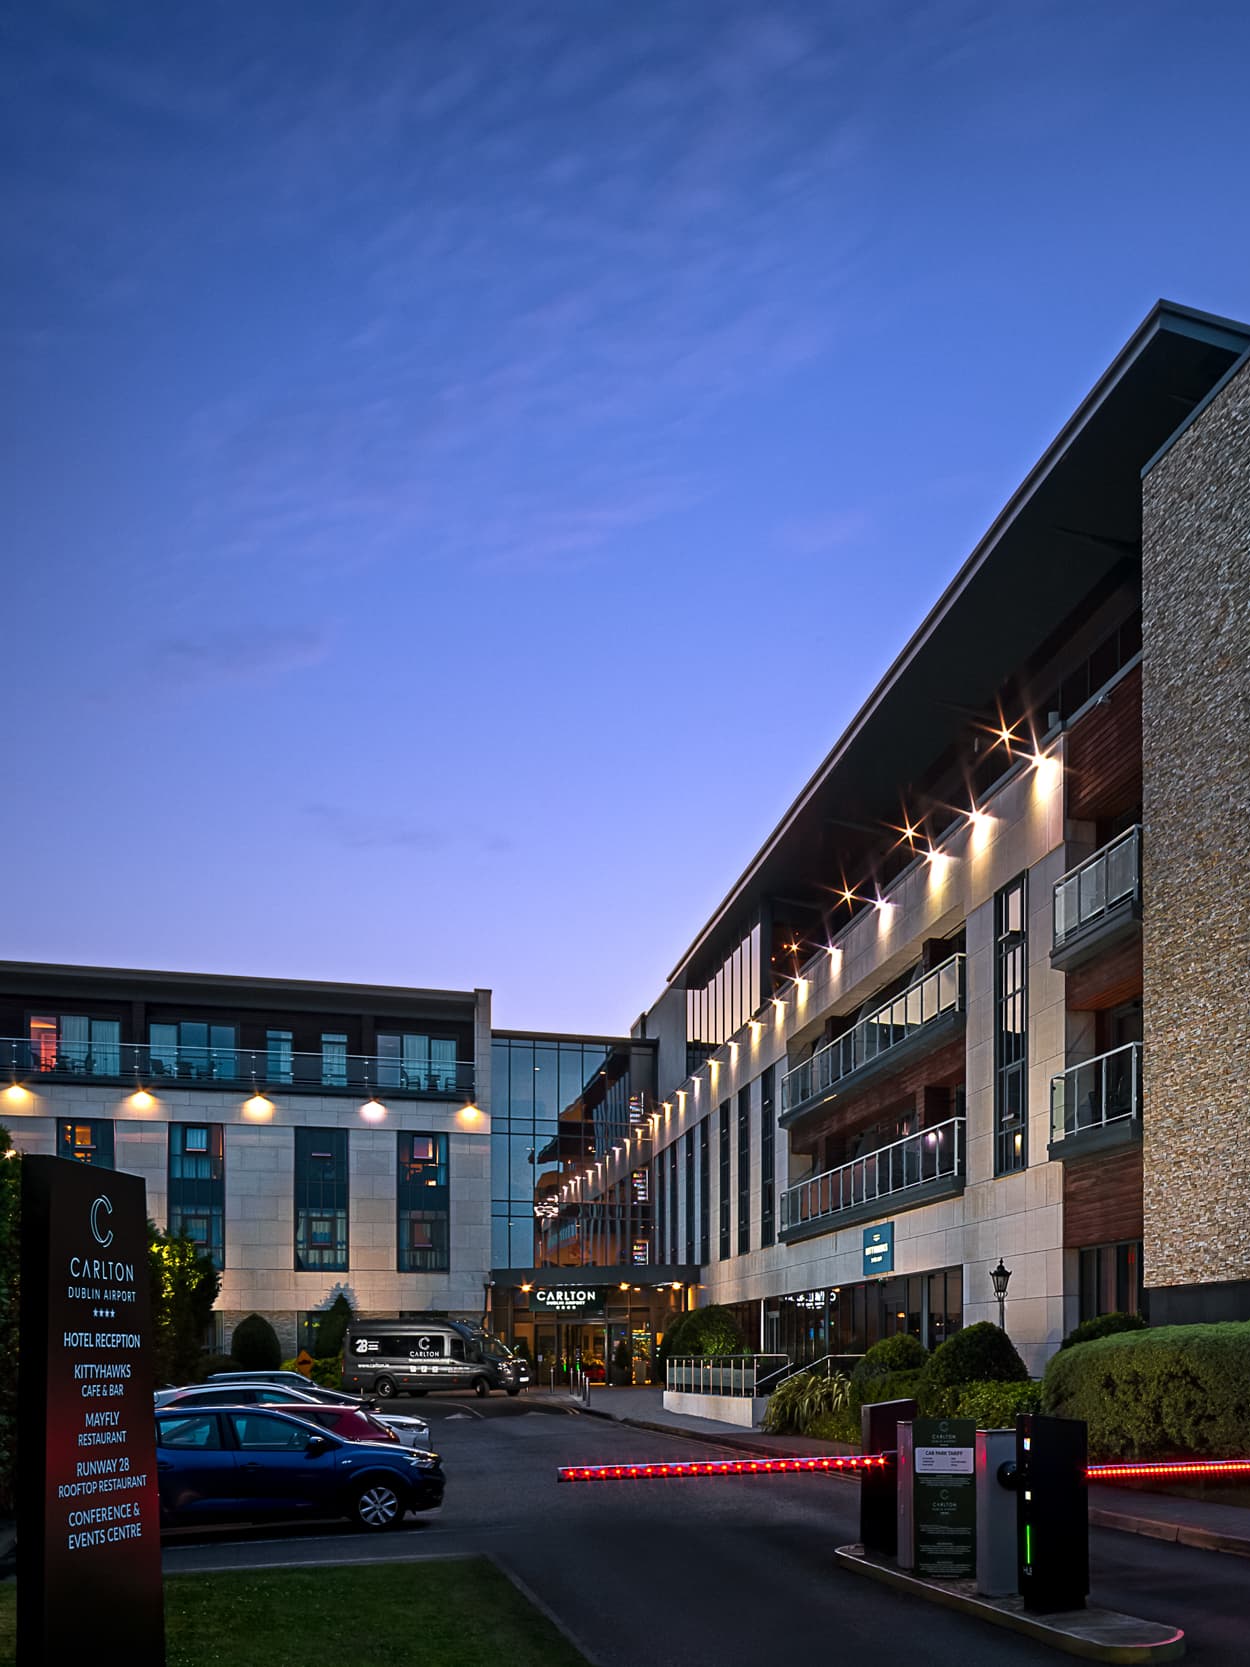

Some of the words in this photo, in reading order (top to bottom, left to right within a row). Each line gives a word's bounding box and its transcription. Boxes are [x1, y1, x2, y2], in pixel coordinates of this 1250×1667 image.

[70, 1257, 135, 1282] CARLTON
[68, 1286, 101, 1300] DUBLIN
[103, 1289, 137, 1302] AIRPORT
[536, 1291, 596, 1301] CARLTON
[63, 1331, 94, 1348] HOTEL
[95, 1332, 141, 1349] RECEPTION
[409, 1350, 440, 1358] CARLTON
[74, 1363, 132, 1379] KITTYHAWKS
[81, 1384, 101, 1397] CAFE
[102, 1384, 108, 1397] &
[109, 1384, 124, 1397] BAR
[85, 1411, 120, 1428] MAYFLY
[78, 1430, 127, 1447] RESTAURANT
[76, 1458, 118, 1478] RUNWAY
[118, 1457, 130, 1472] 28
[58, 1481, 97, 1499] ROOFTOP
[98, 1474, 147, 1493] RESTAURANT
[68, 1503, 132, 1527] CONFERENCE
[133, 1502, 141, 1517] &
[68, 1529, 105, 1550] EVENTS
[107, 1522, 142, 1543] CENTRE
